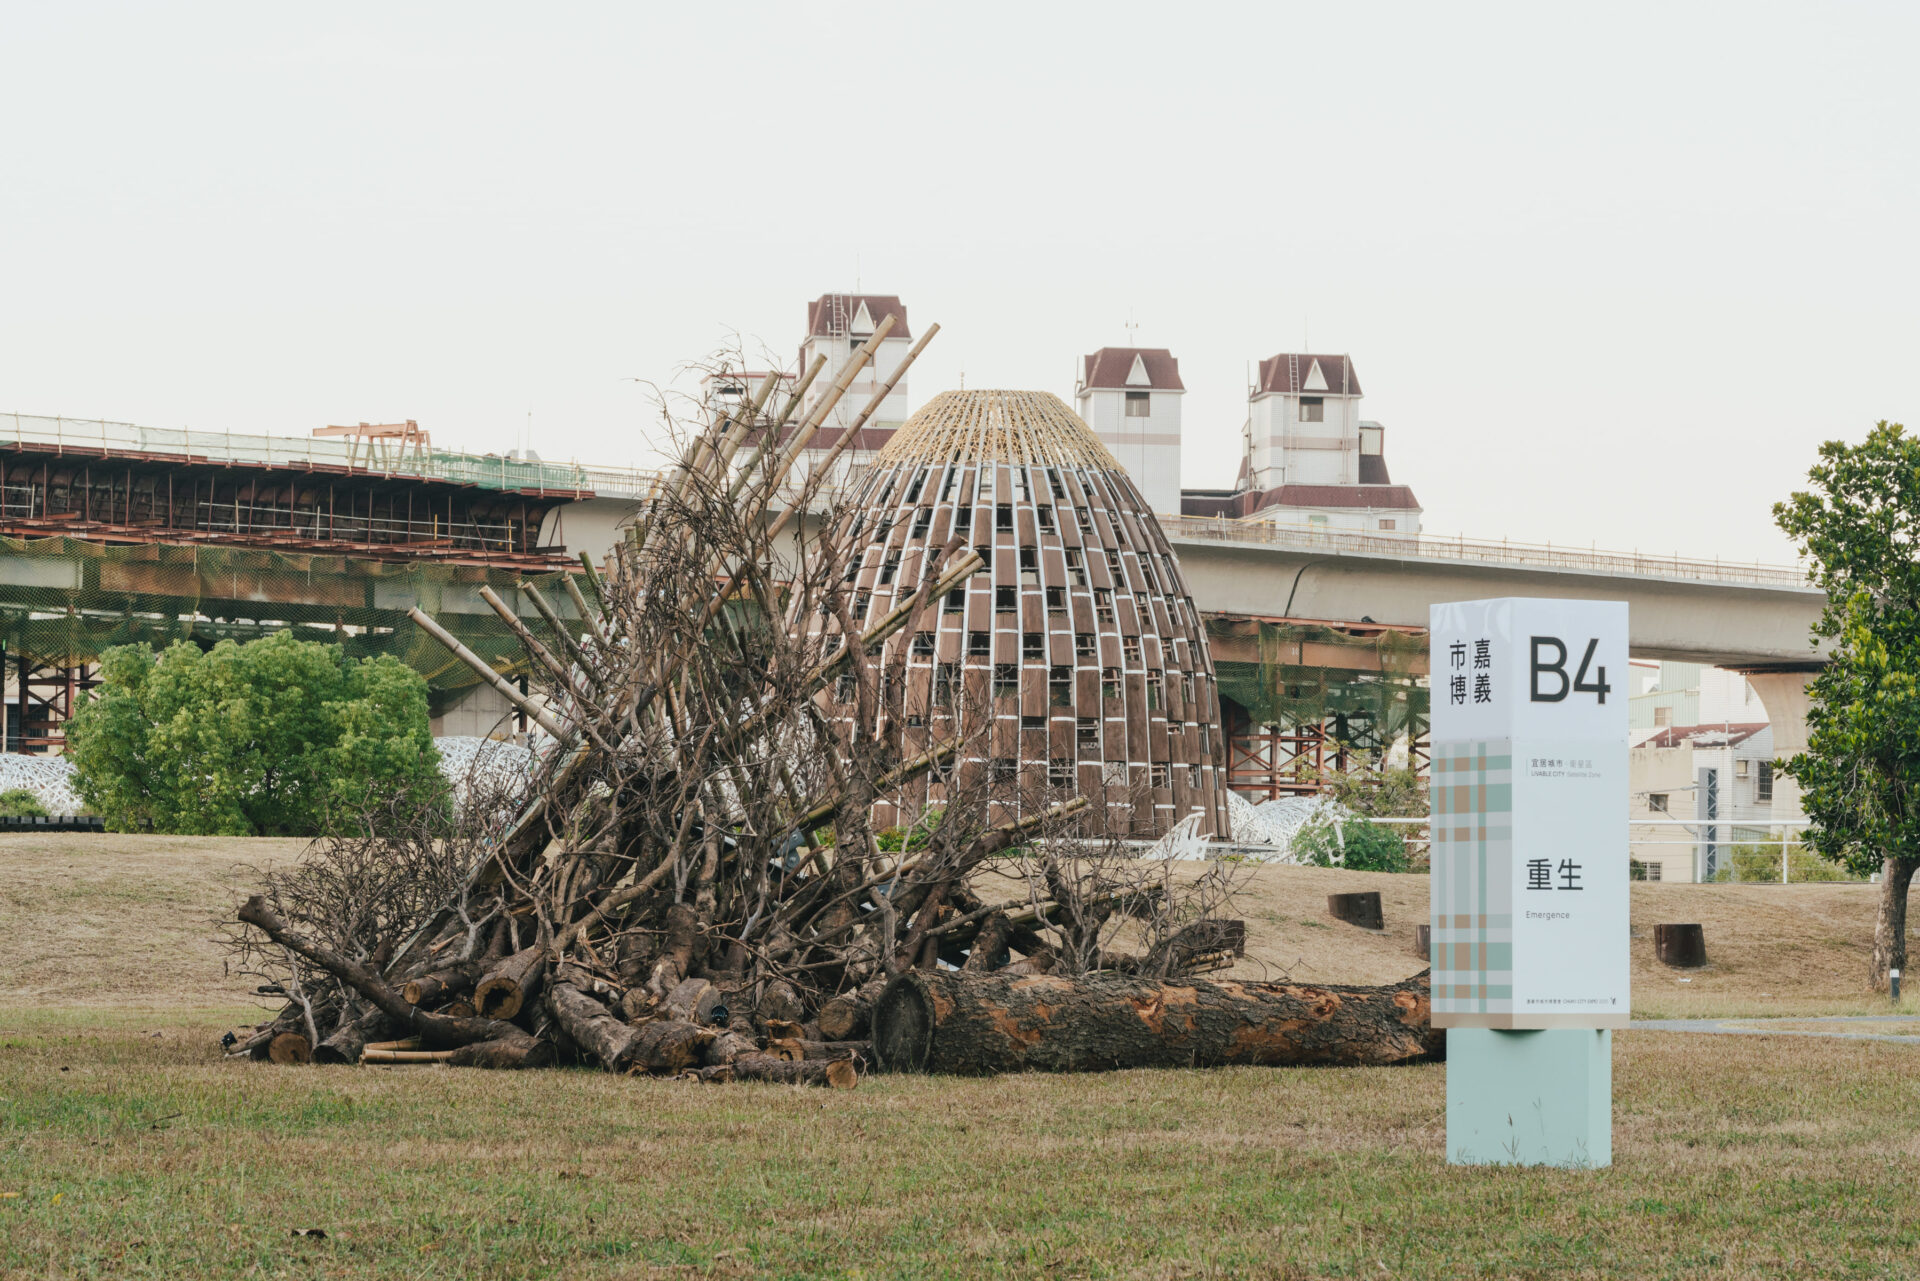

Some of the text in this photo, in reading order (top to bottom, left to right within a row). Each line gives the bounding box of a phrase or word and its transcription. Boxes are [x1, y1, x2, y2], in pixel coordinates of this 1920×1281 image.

[1449, 639, 1468, 705] 市博
[1473, 637, 1492, 704] 嘉義
[1530, 635, 1612, 705] B4
[1526, 857, 1584, 891] 重生
[1525, 910, 1571, 921] Emergence
